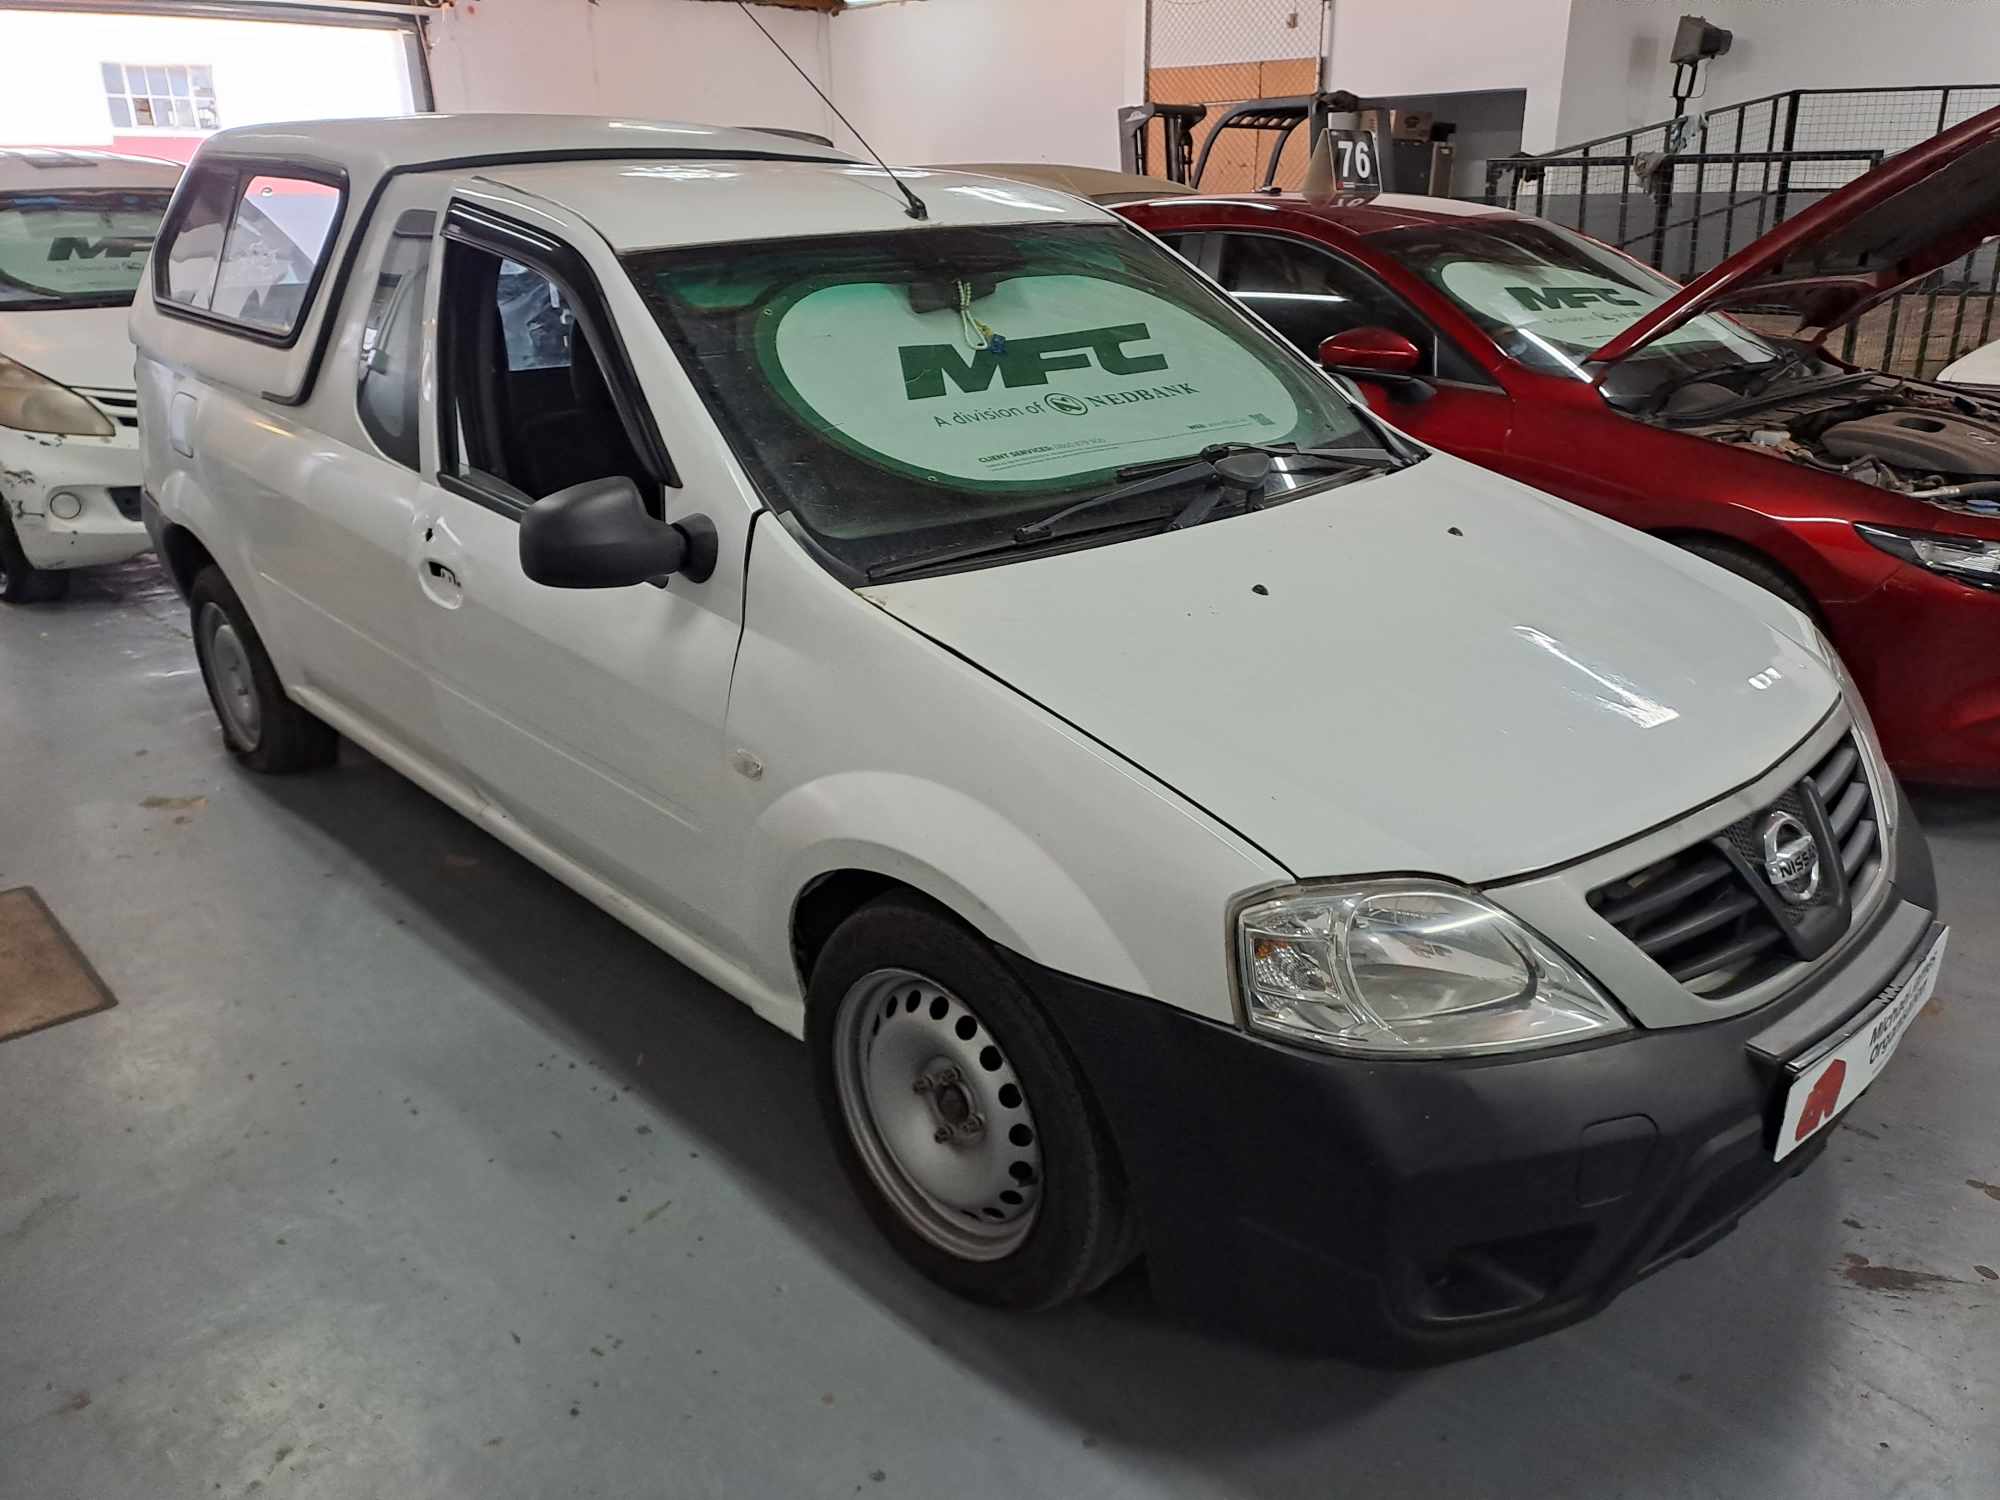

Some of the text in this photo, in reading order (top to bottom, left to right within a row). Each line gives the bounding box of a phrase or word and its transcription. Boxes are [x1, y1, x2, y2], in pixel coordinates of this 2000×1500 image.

[1338, 141, 1371, 178] 76
[47, 237, 153, 261] MF
[1504, 287, 1641, 311] MFC
[898, 322, 1168, 400] MFC
[934, 382, 1199, 428] A division of NEDBANK
